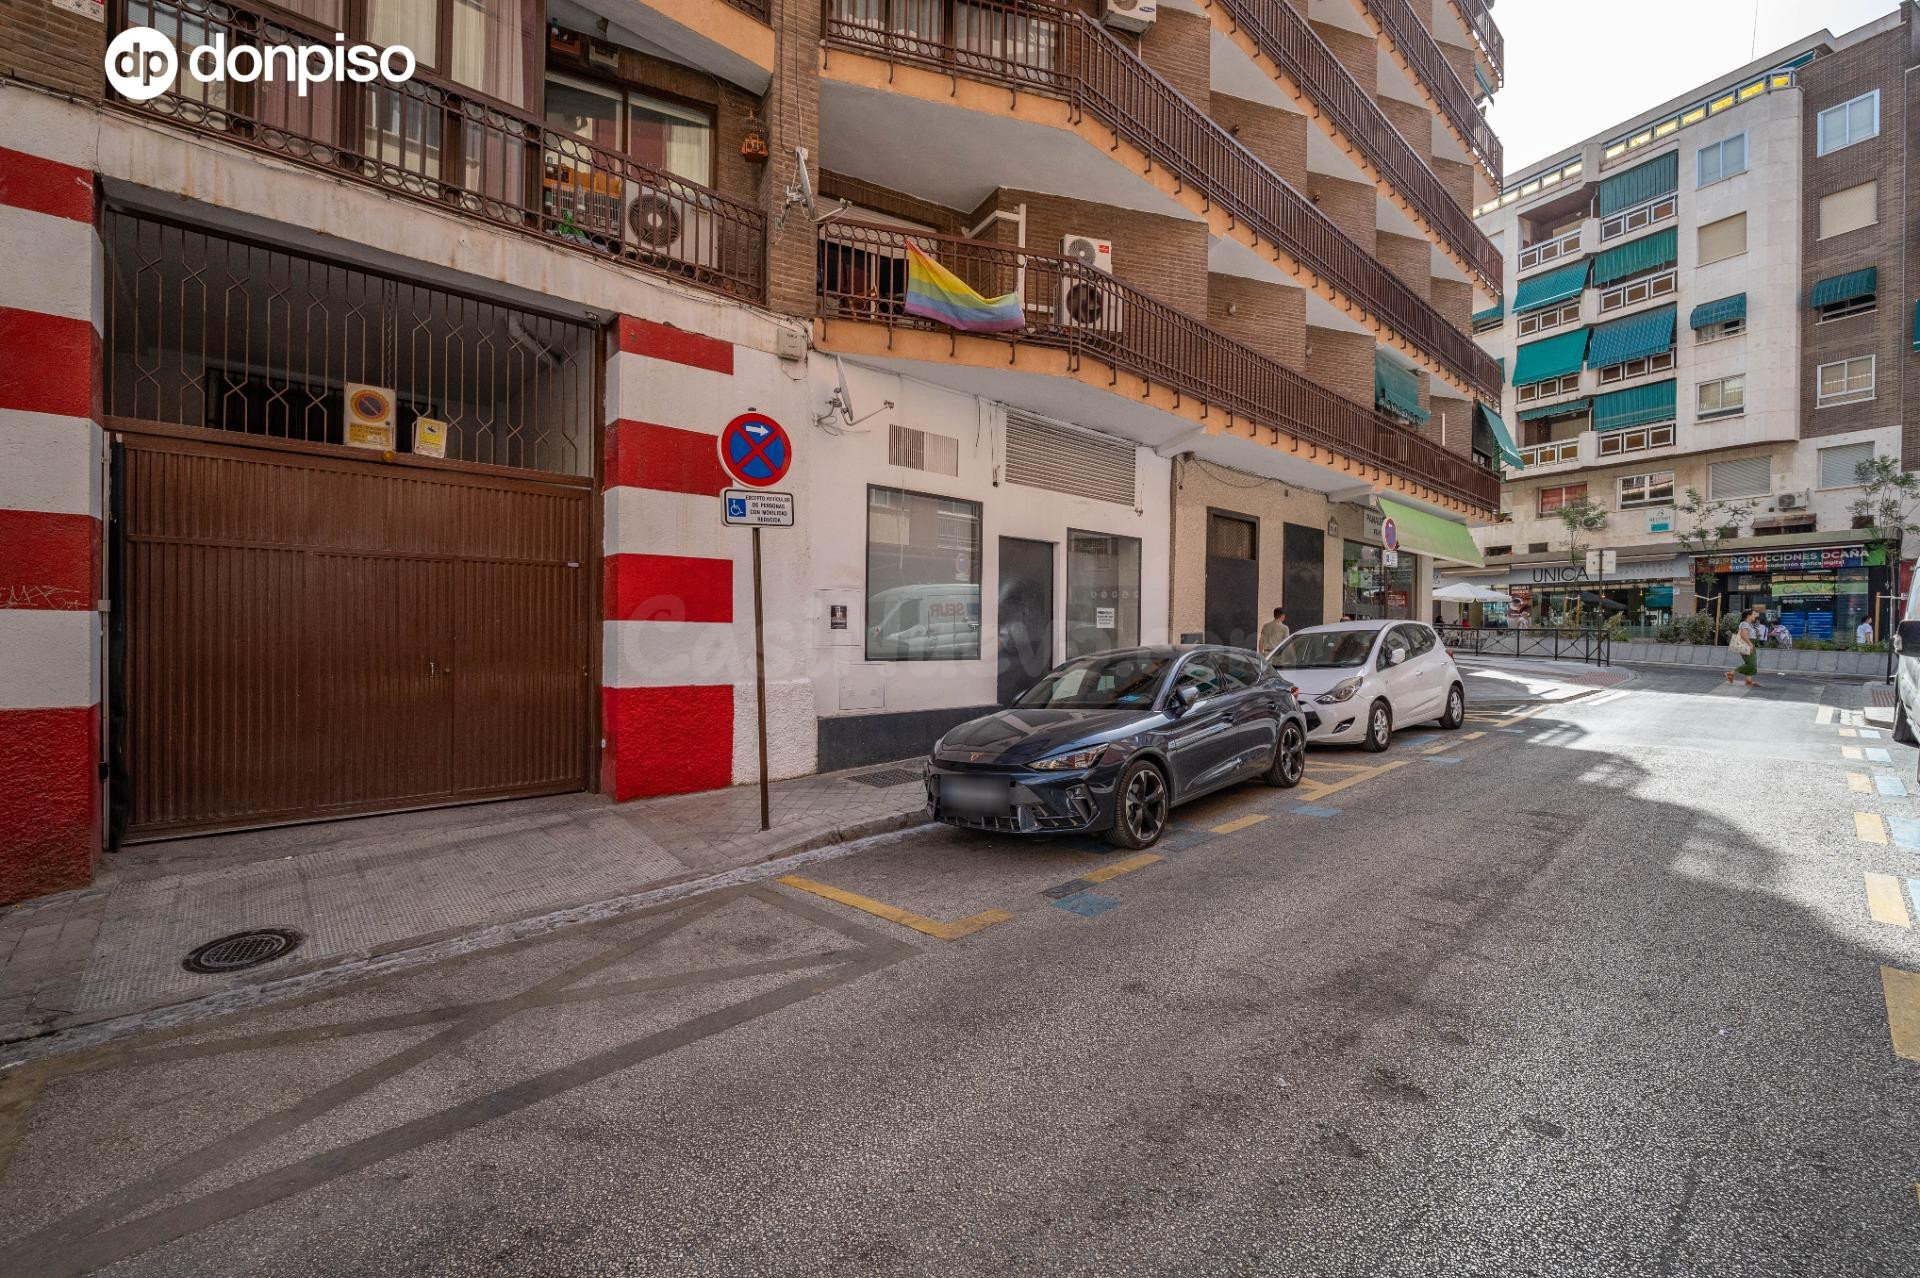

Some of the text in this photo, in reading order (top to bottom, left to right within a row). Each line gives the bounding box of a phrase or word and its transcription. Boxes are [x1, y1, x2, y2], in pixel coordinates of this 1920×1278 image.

[1709, 546, 1870, 565] REPRODUCCIONES OCAÑA
[1823, 559, 1846, 567] digital
